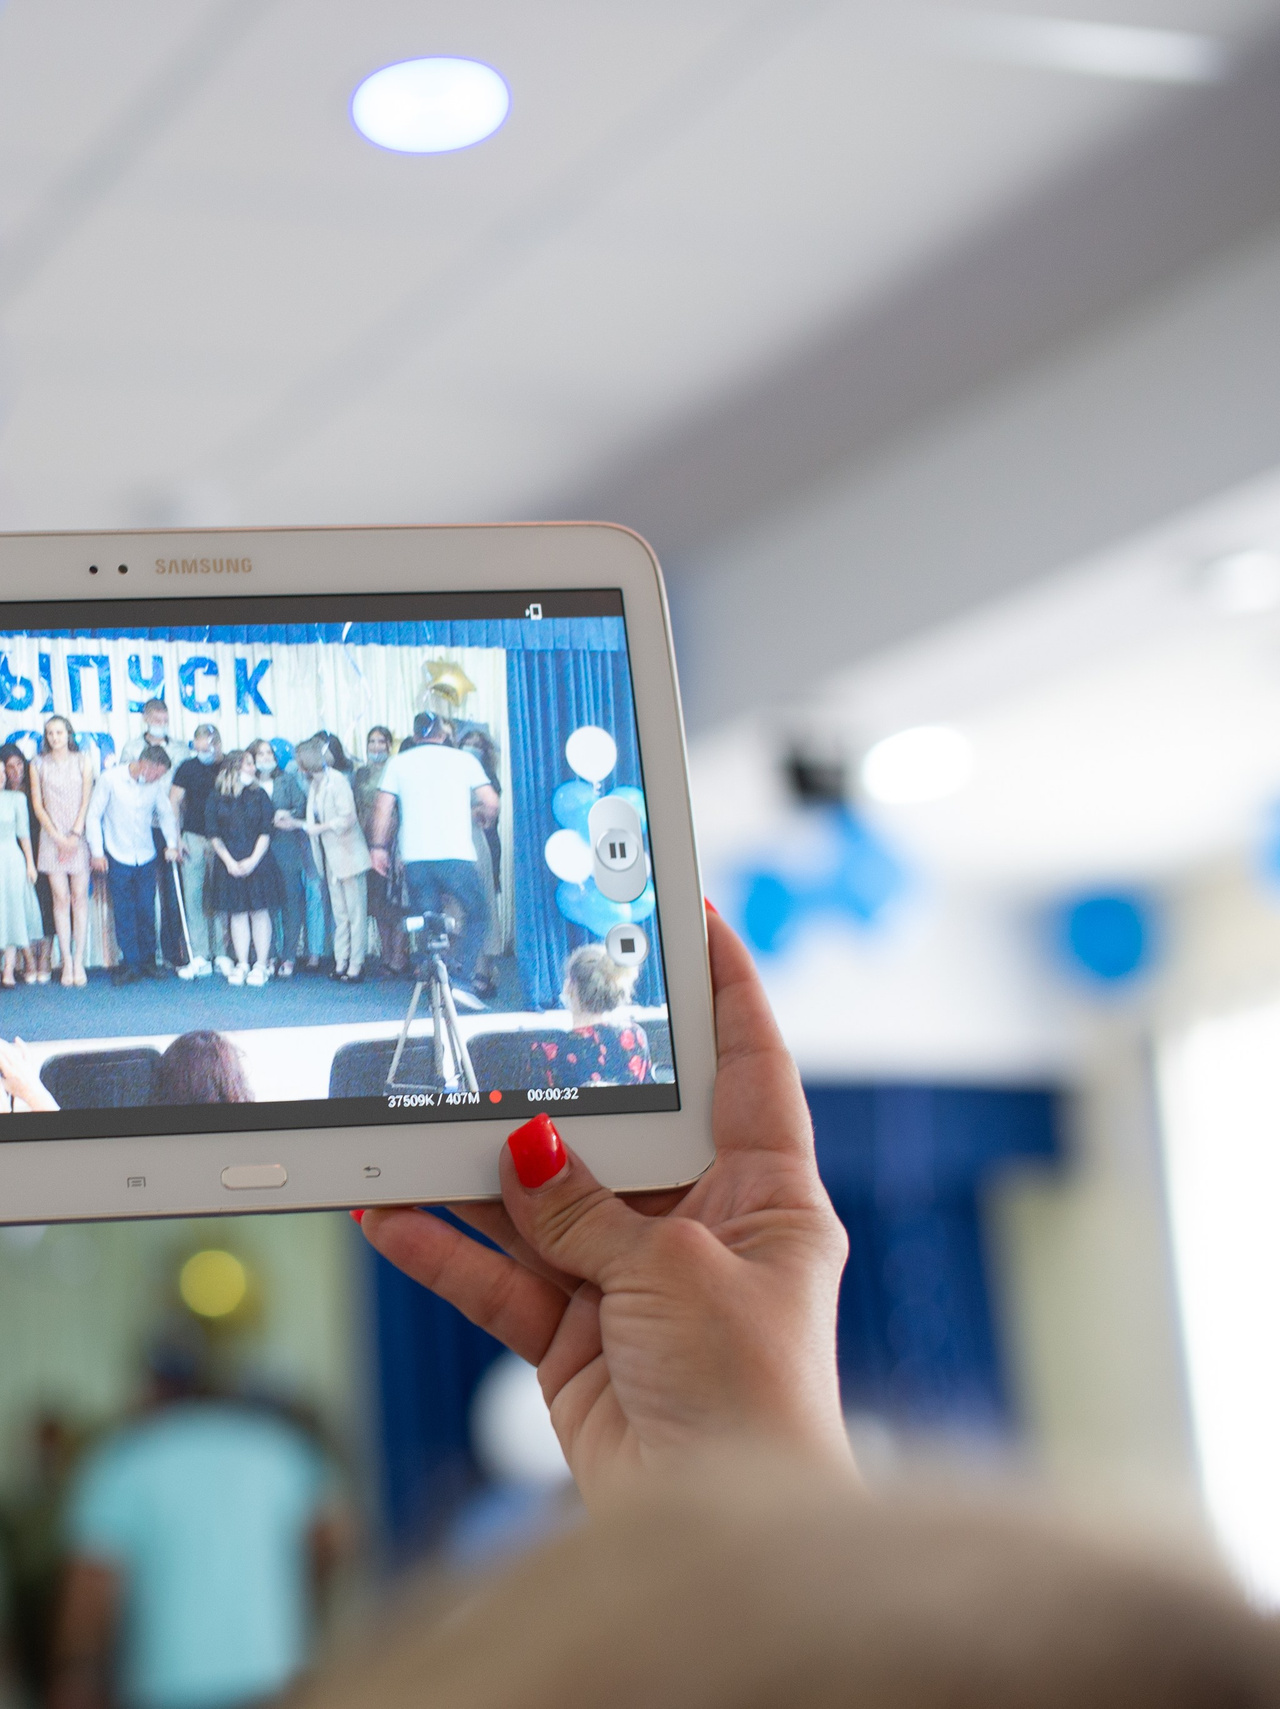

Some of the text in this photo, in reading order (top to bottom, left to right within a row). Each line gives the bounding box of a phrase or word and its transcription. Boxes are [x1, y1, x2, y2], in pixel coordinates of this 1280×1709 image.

[154, 557, 253, 575] SAMSUNG
[387, 1091, 480, 1108] 37509K / 407M
[527, 1086, 579, 1102] 00:00:32
